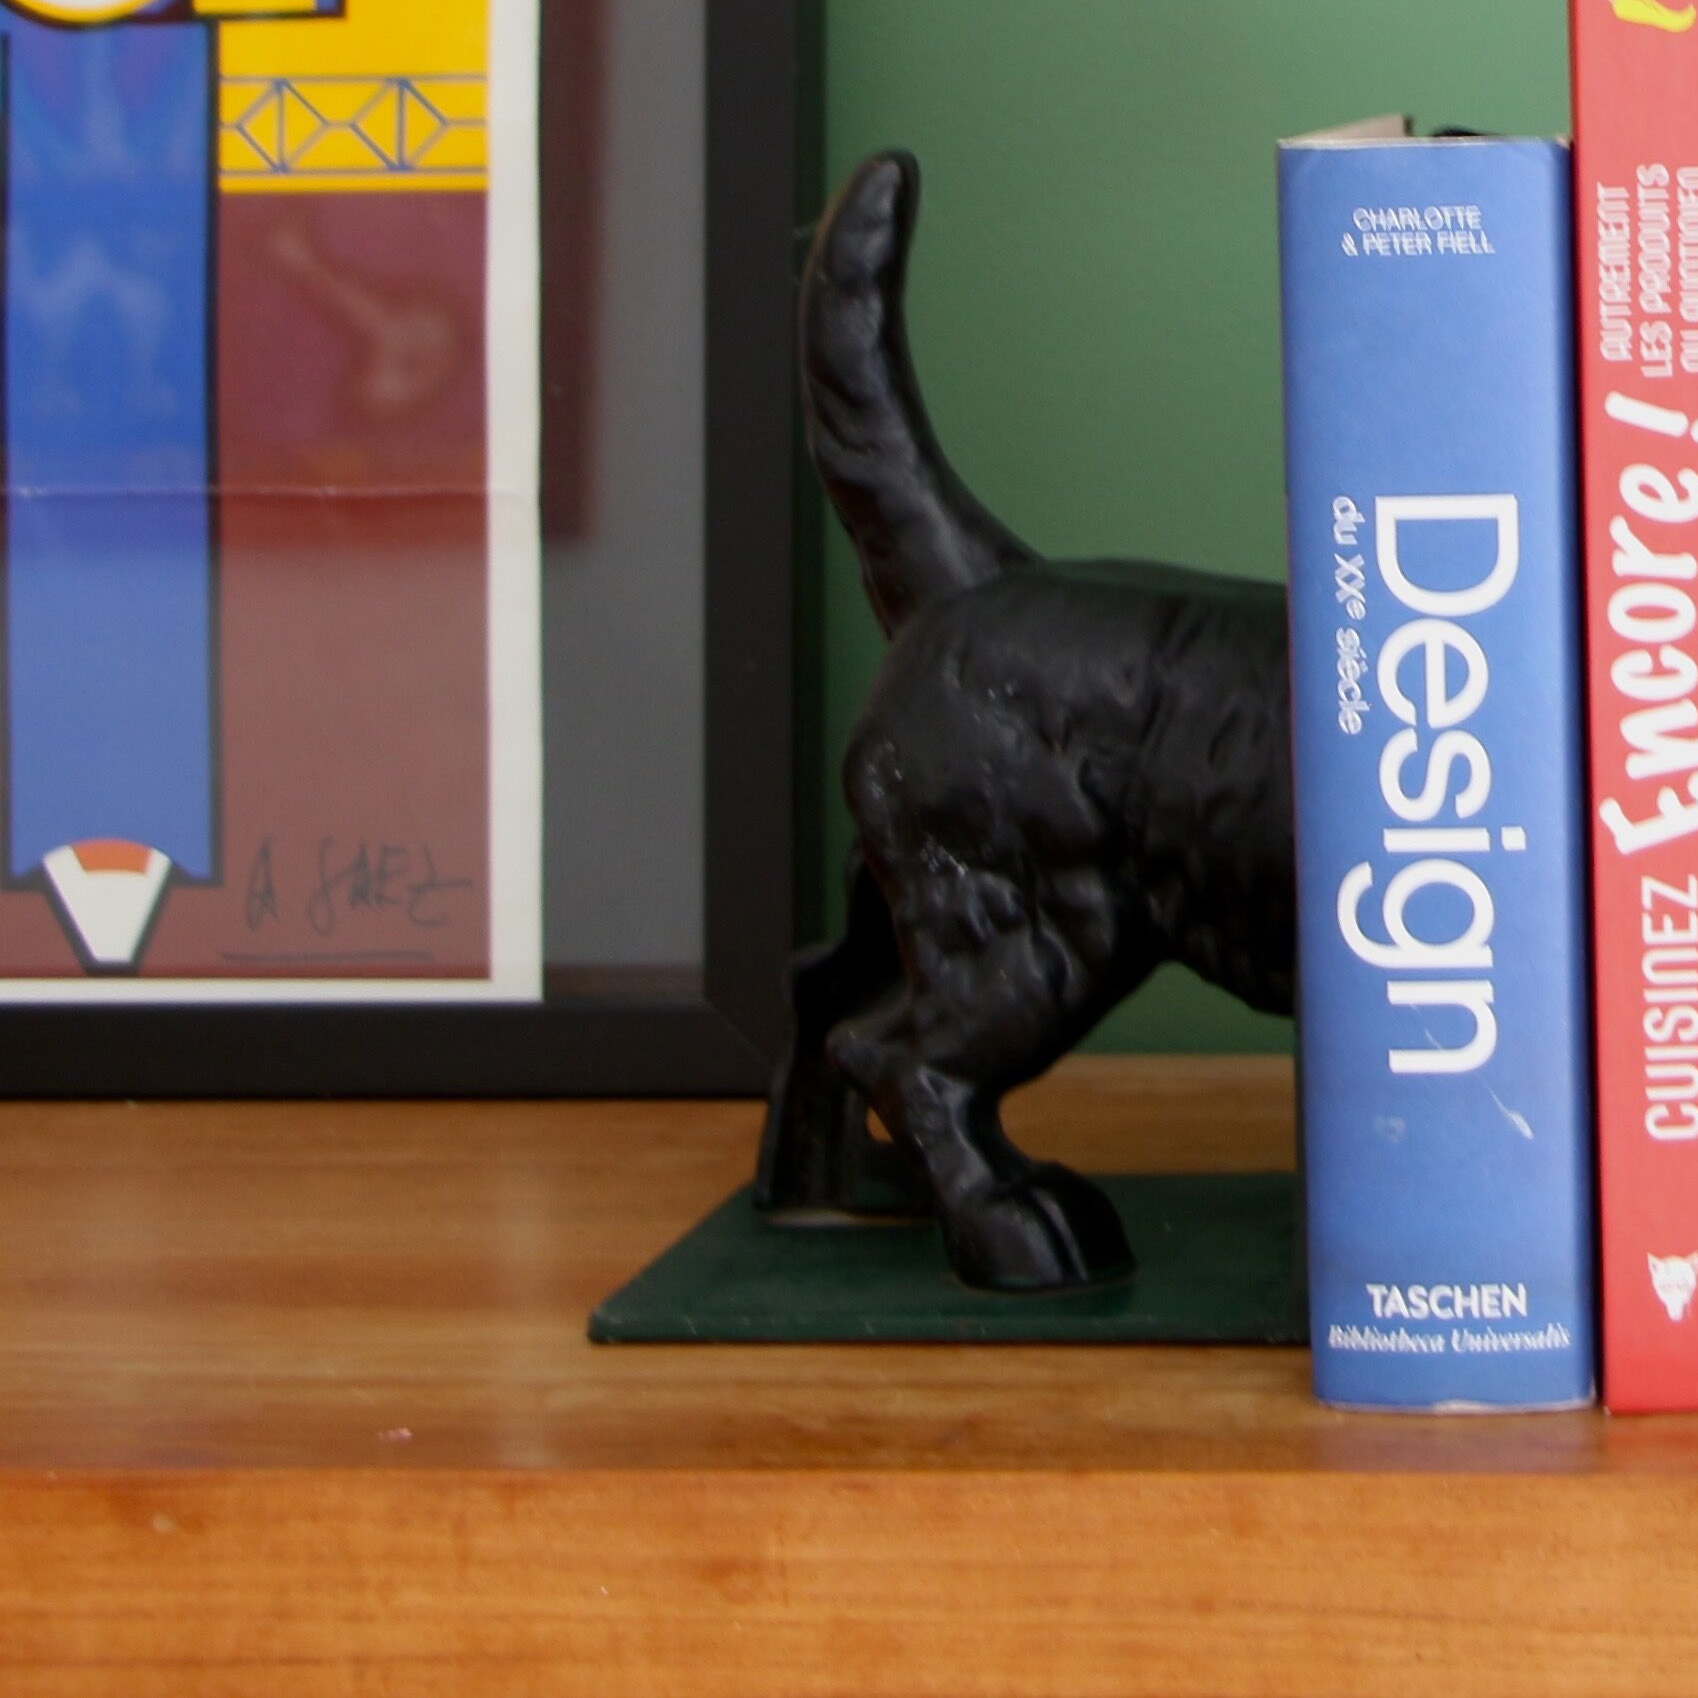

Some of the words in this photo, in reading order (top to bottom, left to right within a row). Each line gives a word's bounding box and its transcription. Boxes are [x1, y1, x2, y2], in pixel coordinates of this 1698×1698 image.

[1340, 232, 1359, 257] &
[1361, 230, 1433, 257] PETER
[1435, 229, 1497, 256] FIELL
[1352, 205, 1483, 233] CHARLOTTE
[1636, 163, 1672, 314] PRODUITS
[1596, 181, 1633, 362] AUTREMENT
[1639, 320, 1674, 378] LES
[1332, 495, 1366, 545] du
[1336, 493, 1527, 1074] Design
[1365, 1282, 1528, 1320] TASCHEN
